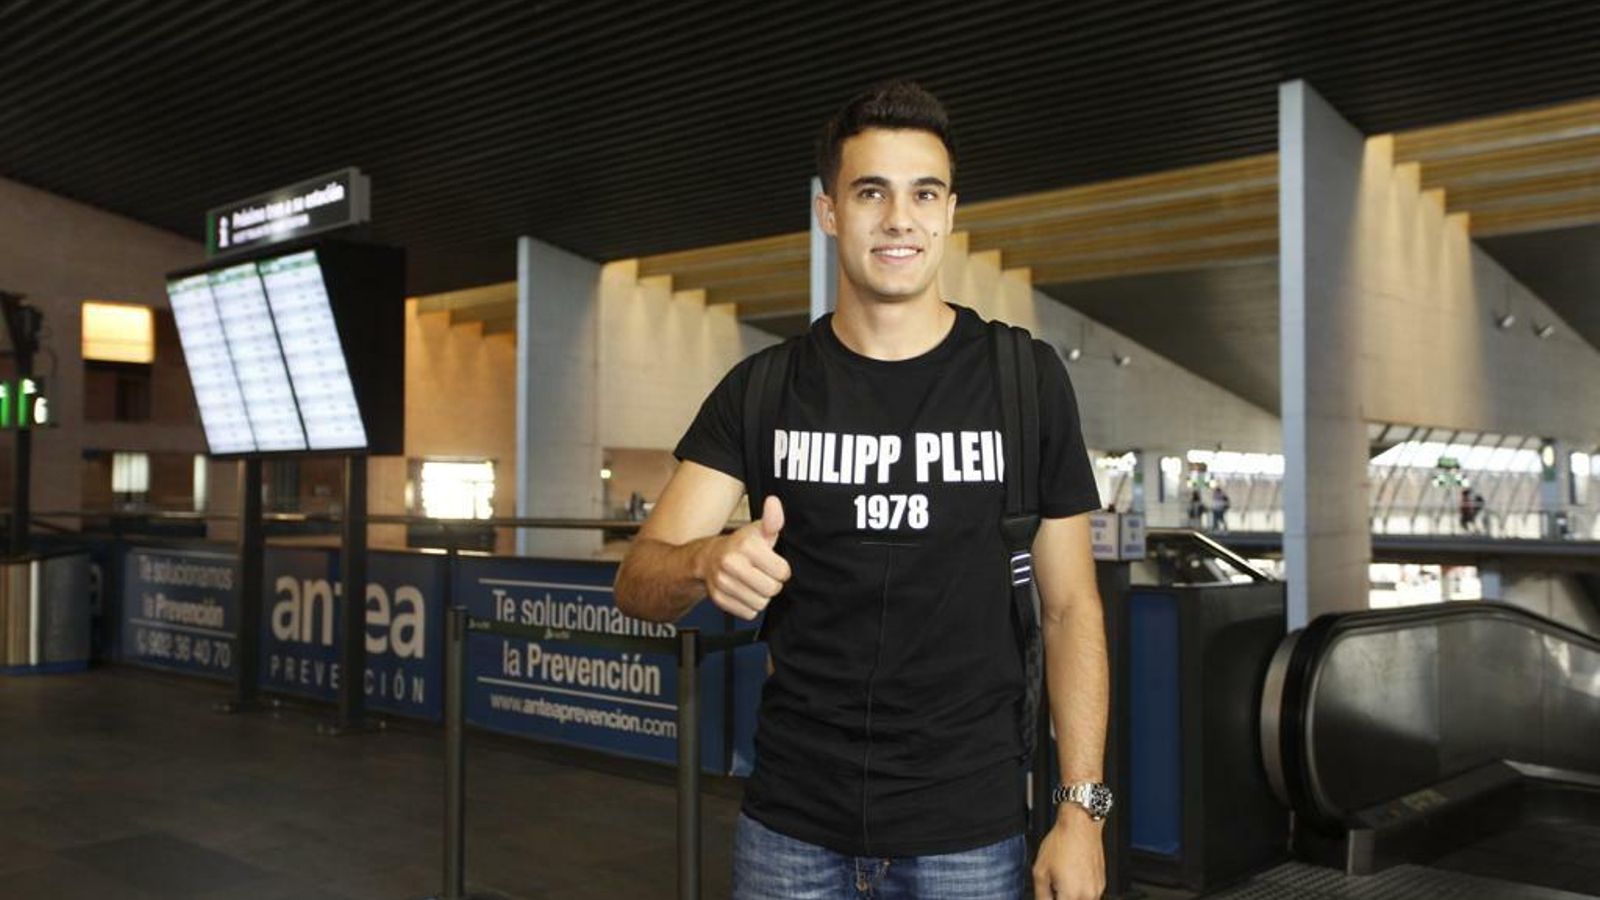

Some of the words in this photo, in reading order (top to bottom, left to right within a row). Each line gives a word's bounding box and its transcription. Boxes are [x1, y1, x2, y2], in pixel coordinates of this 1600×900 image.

[774, 429, 902, 484] PHILIPP
[854, 493, 929, 530] 1978
[272, 575, 425, 659] anea
[492, 589, 516, 623] Te
[213, 640, 231, 669] 70
[502, 639, 521, 677] la
[526, 643, 661, 696] Prevención
[270, 654, 425, 704] PREVECIÓN
[490, 693, 678, 739] www.anteaprevencion.com
